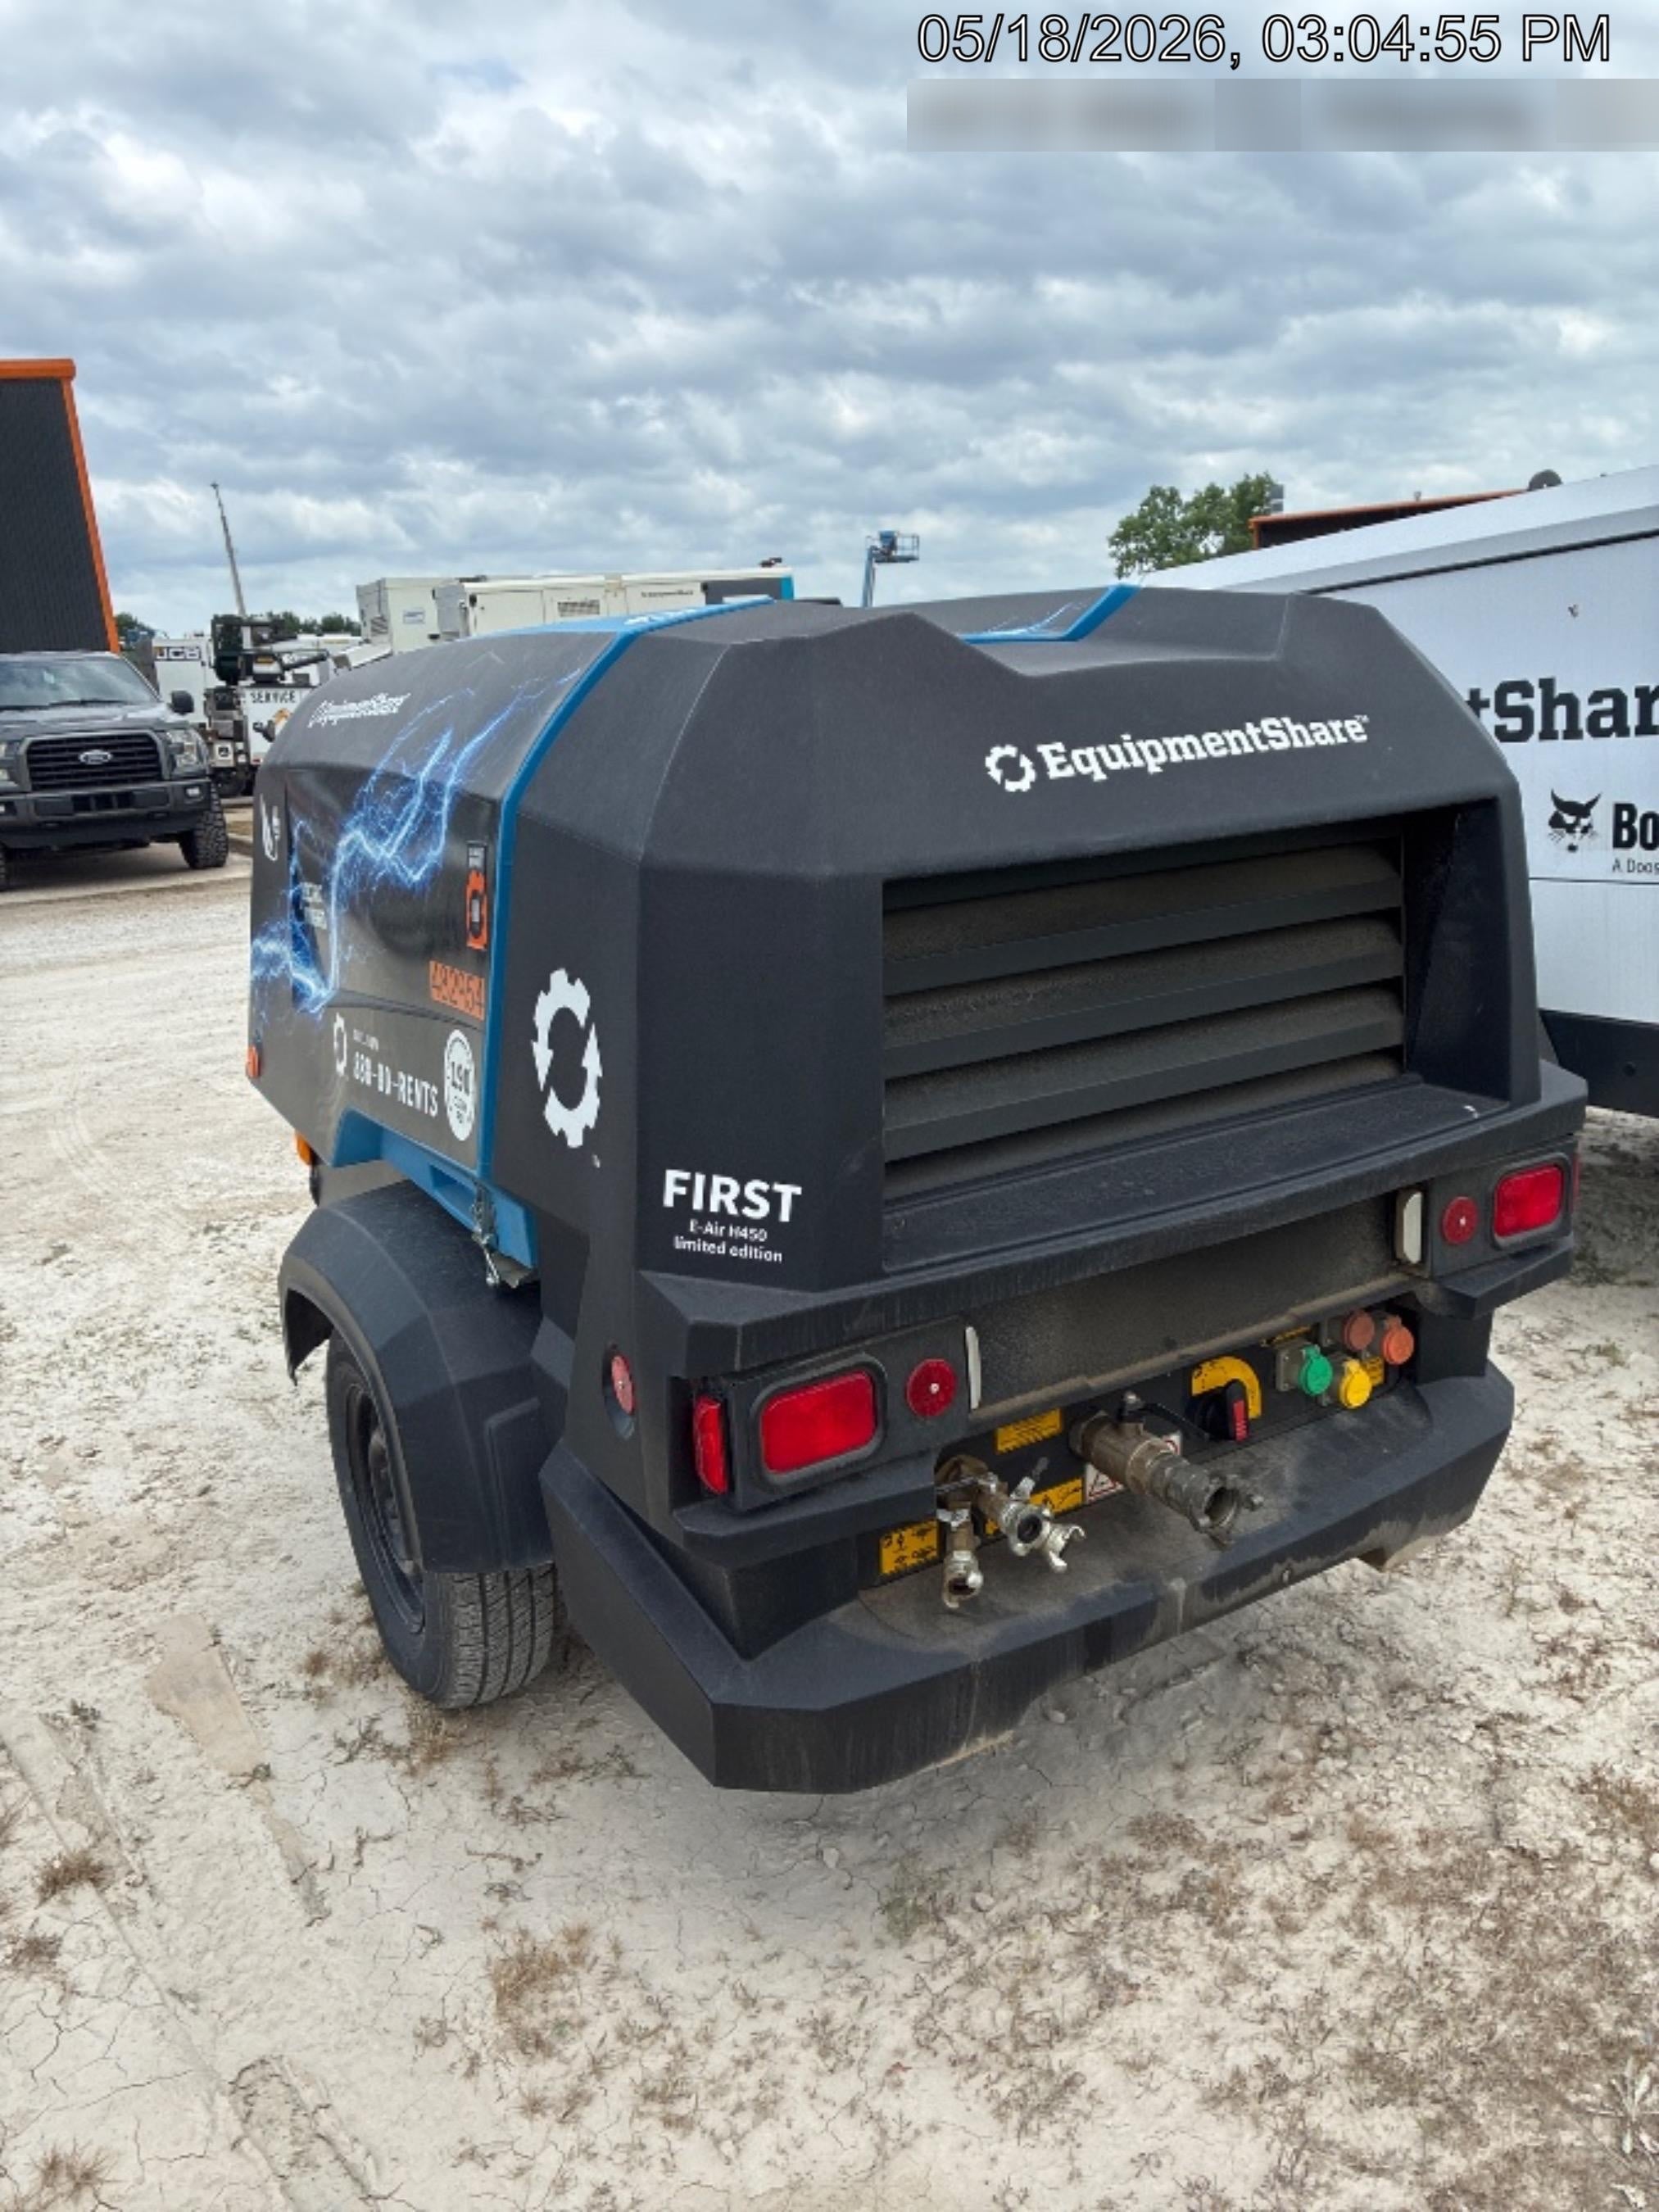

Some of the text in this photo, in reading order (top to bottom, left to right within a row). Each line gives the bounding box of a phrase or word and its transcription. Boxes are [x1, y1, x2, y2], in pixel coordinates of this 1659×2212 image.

[663, 1168, 803, 1222] FIRST
[673, 1235, 783, 1263] limited edition
